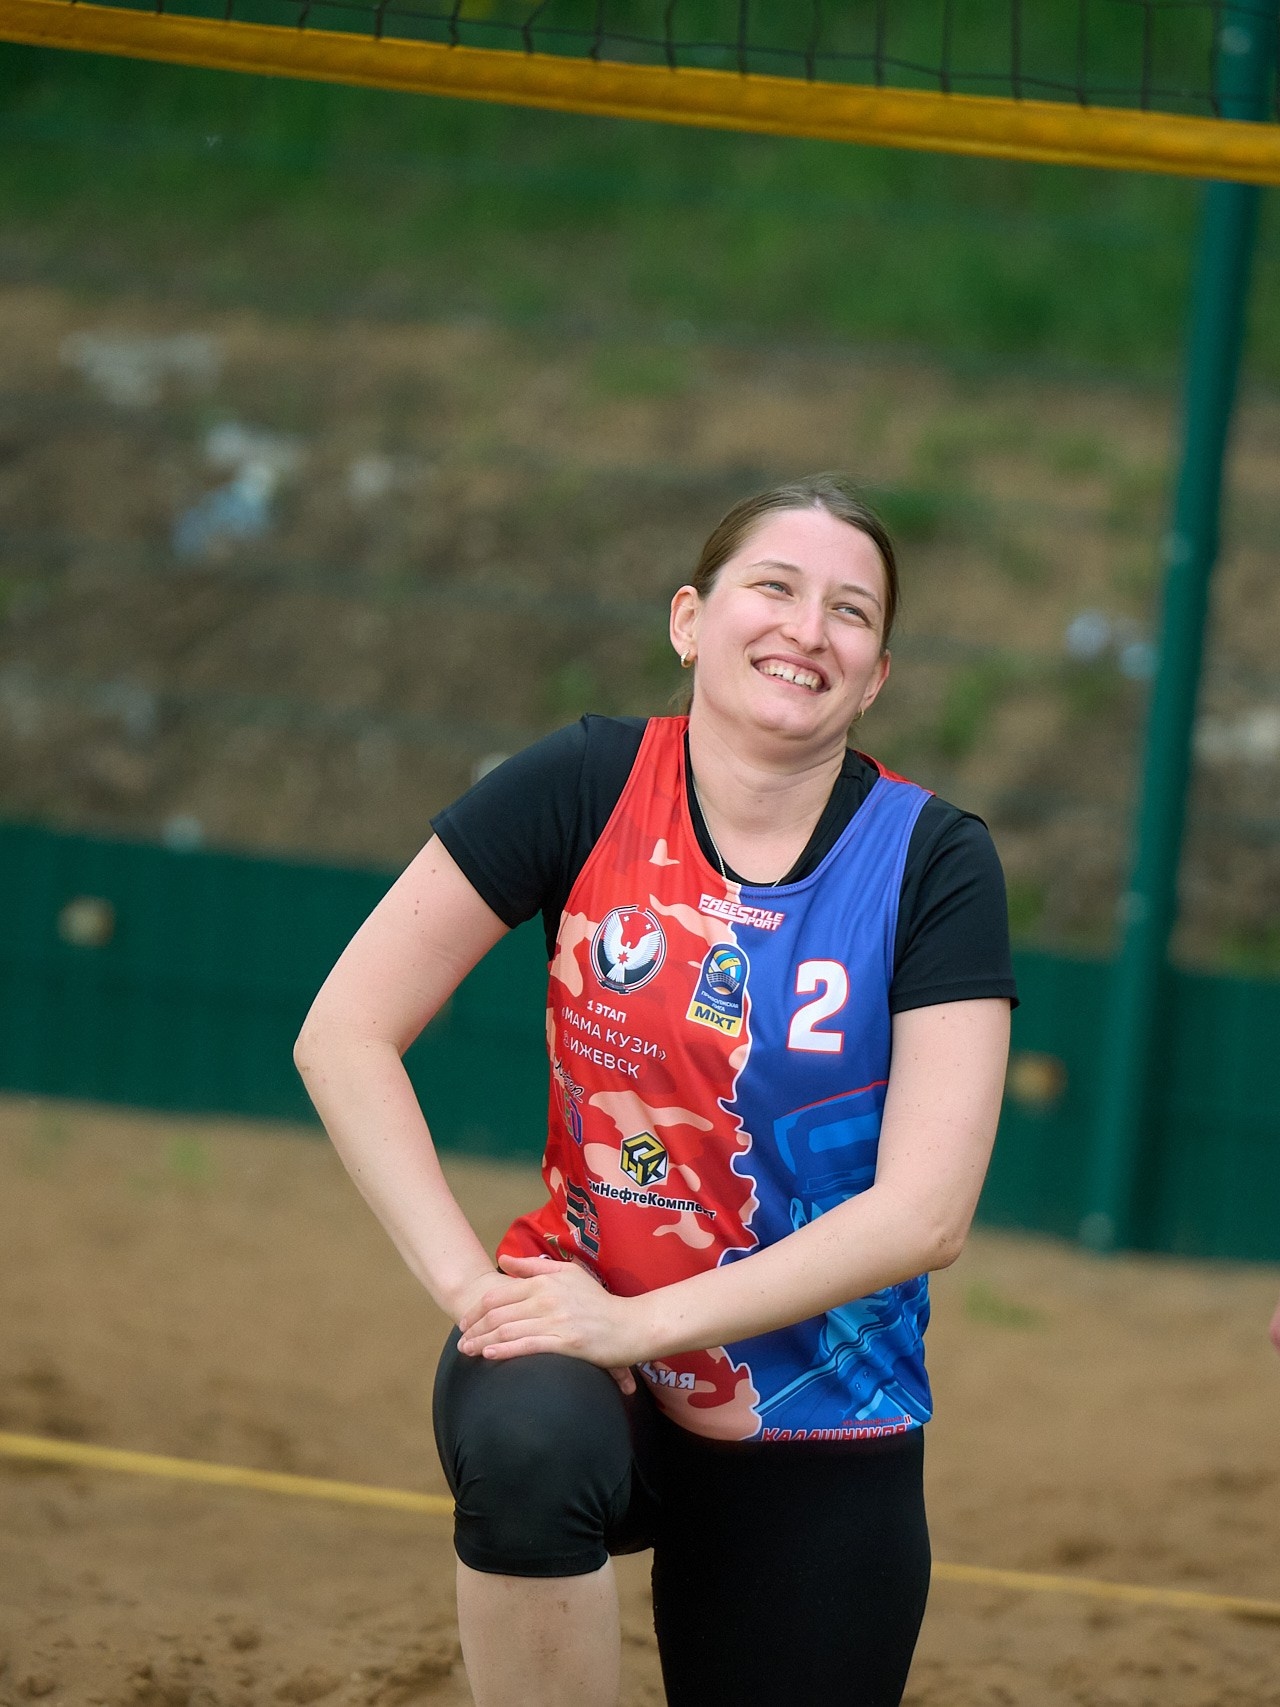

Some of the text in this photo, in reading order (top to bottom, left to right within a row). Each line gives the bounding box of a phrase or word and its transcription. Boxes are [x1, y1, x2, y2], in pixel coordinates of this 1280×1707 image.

[594, 1002, 627, 1024] ЭТАП
[694, 1005, 736, 1030] MIXT
[786, 958, 850, 1055] 2
